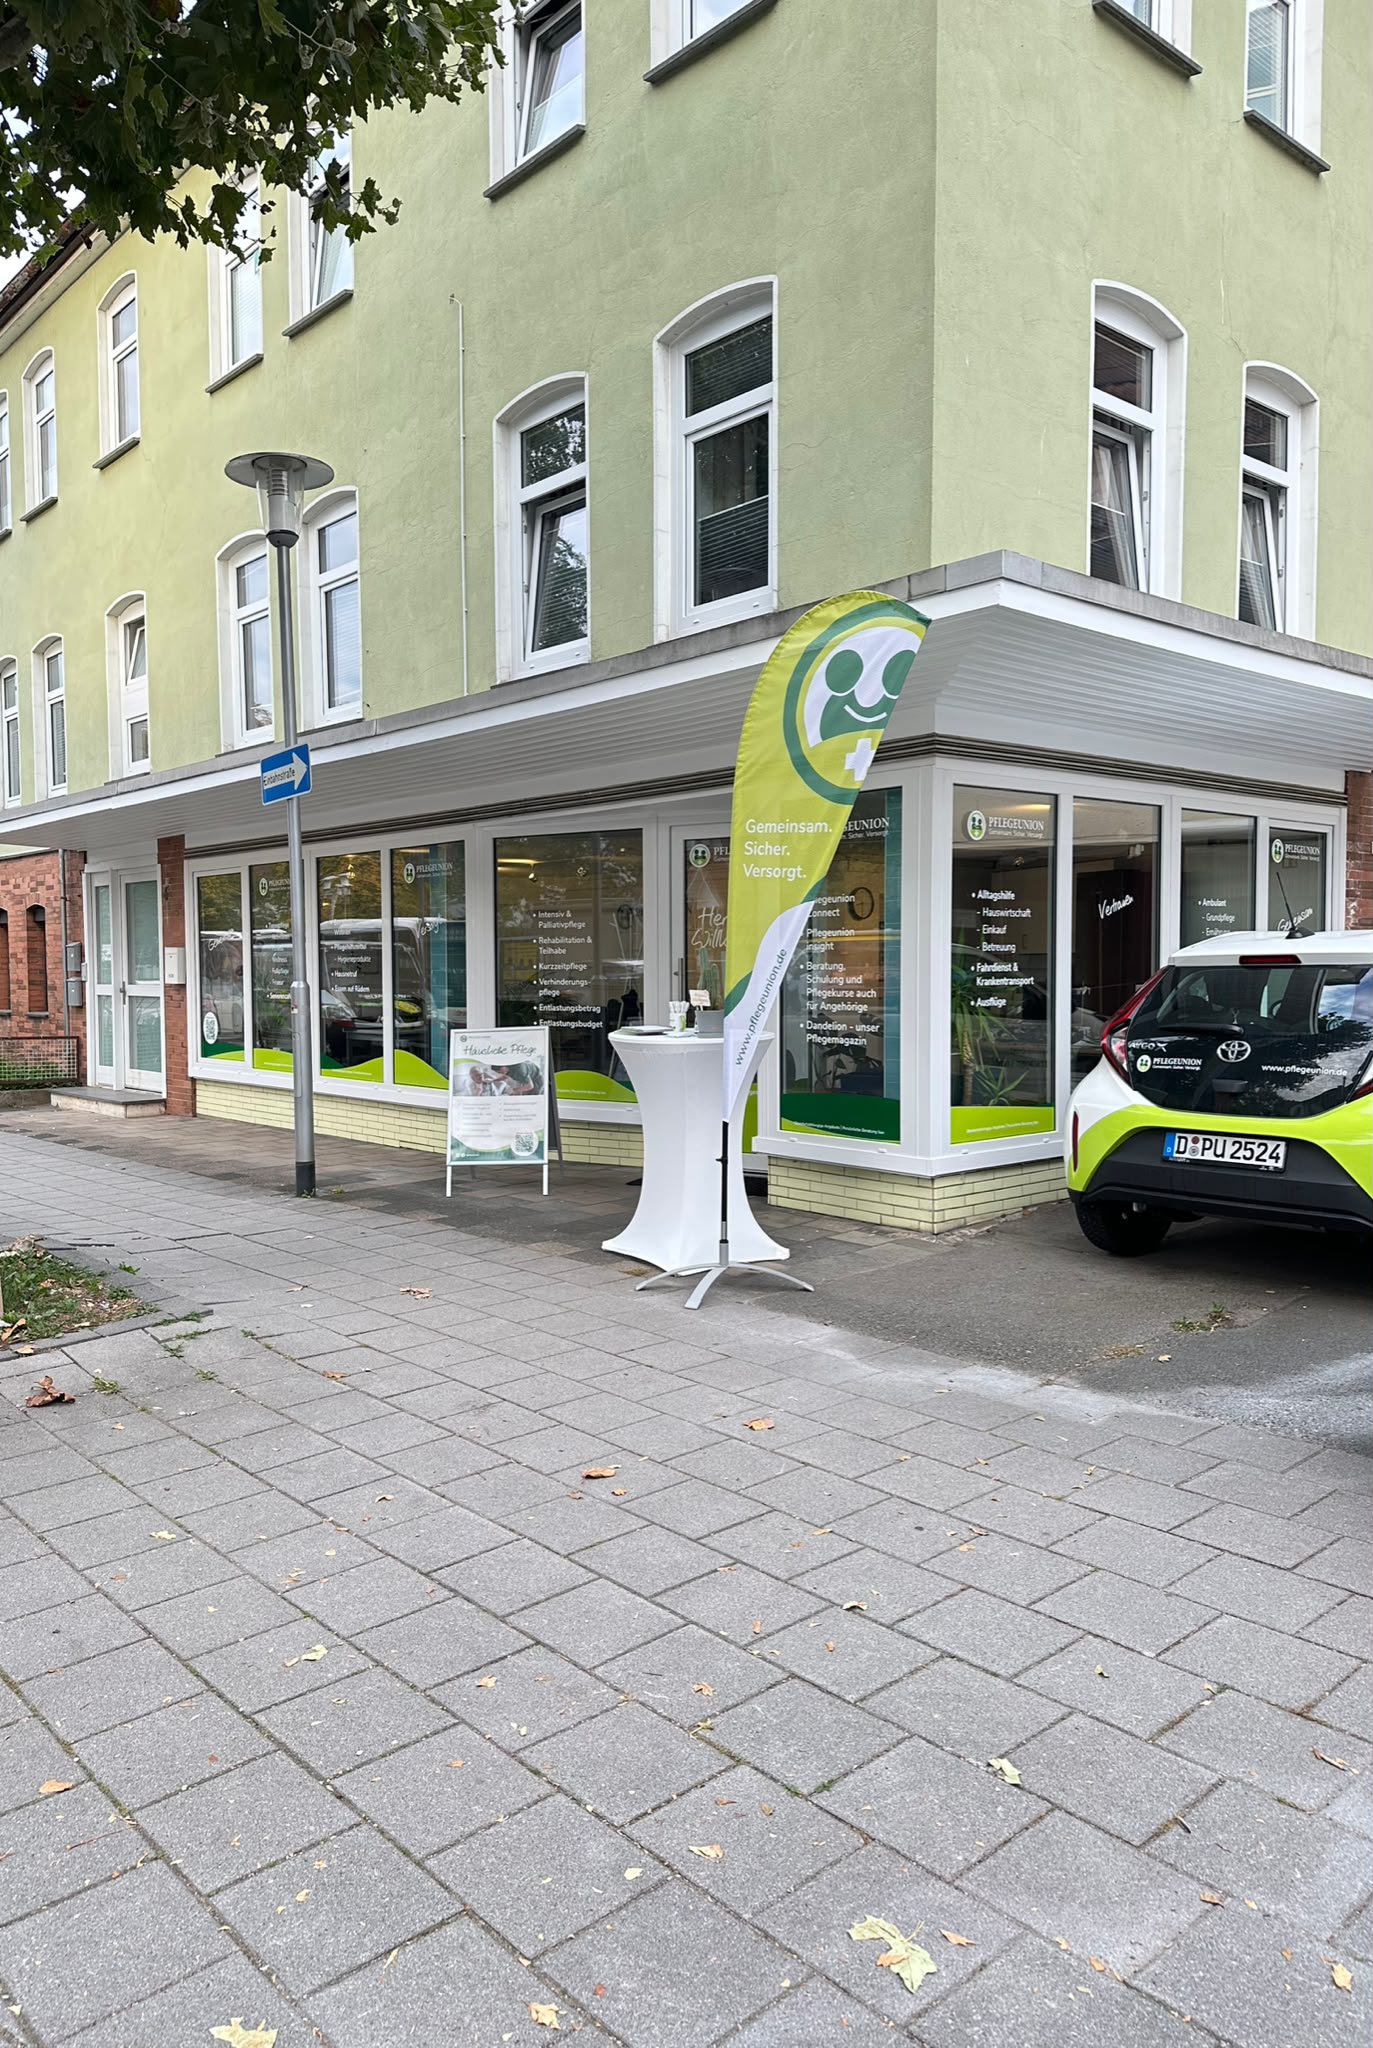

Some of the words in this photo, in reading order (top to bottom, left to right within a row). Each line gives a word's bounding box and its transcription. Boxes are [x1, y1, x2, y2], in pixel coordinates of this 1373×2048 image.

[745, 819, 832, 834] Gemeinsam.
[843, 817, 890, 831] EUNION
[988, 816, 1045, 831] PFLEGEUNION
[744, 841, 790, 856] Sicher.
[743, 863, 807, 882] Versorgt.
[977, 889, 1016, 902] Alltagshilfe
[1202, 898, 1227, 907] Ambulant
[538, 910, 564, 919] Intensiv
[566, 910, 572, 919] &
[982, 907, 1032, 918] Hauswirtschaft
[1206, 912, 1236, 924] Grundpflege
[538, 921, 586, 930] Palliativpflege
[982, 924, 1008, 934] Einkauf
[806, 928, 855, 939] Pflegeunion
[538, 936, 584, 945] Rehabilitation
[586, 936, 593, 945] &
[538, 947, 567, 956] Teilhabe
[806, 942, 834, 952] insight
[982, 941, 1016, 954] Betreuung
[538, 962, 588, 972] Kurzzeitpflege
[806, 961, 846, 973] Beratung,
[976, 962, 1012, 972] Fahrdienst
[1012, 962, 1019, 972] &
[335, 970, 358, 978] Hausnotruf
[538, 978, 592, 988] Verhinderungs-
[806, 974, 844, 986] Schulung
[846, 975, 863, 984] und
[976, 976, 1035, 987] Krankentransport
[539, 989, 561, 999] pflege
[806, 988, 855, 1000] Pflegekurse
[856, 989, 877, 999] auch
[735, 949, 787, 1065] www.pflegeunion.de
[806, 1001, 818, 1011] für
[819, 1001, 869, 1014] Angehörige
[976, 997, 1007, 1008] Ausflüge
[539, 1003, 601, 1014] Entlastungsbetrag
[539, 1019, 603, 1029] Entlastungsbudget
[806, 1020, 848, 1031] Dandelion
[855, 1024, 881, 1034] unser
[806, 1033, 868, 1047] Pflegemagazin
[1153, 1057, 1203, 1066] PFLEGEUNION
[1261, 1064, 1348, 1077] www.pflegeunion.de
[1175, 1135, 1188, 1155] D
[1201, 1137, 1227, 1159] PU
[1229, 1140, 1281, 1165] 2524
